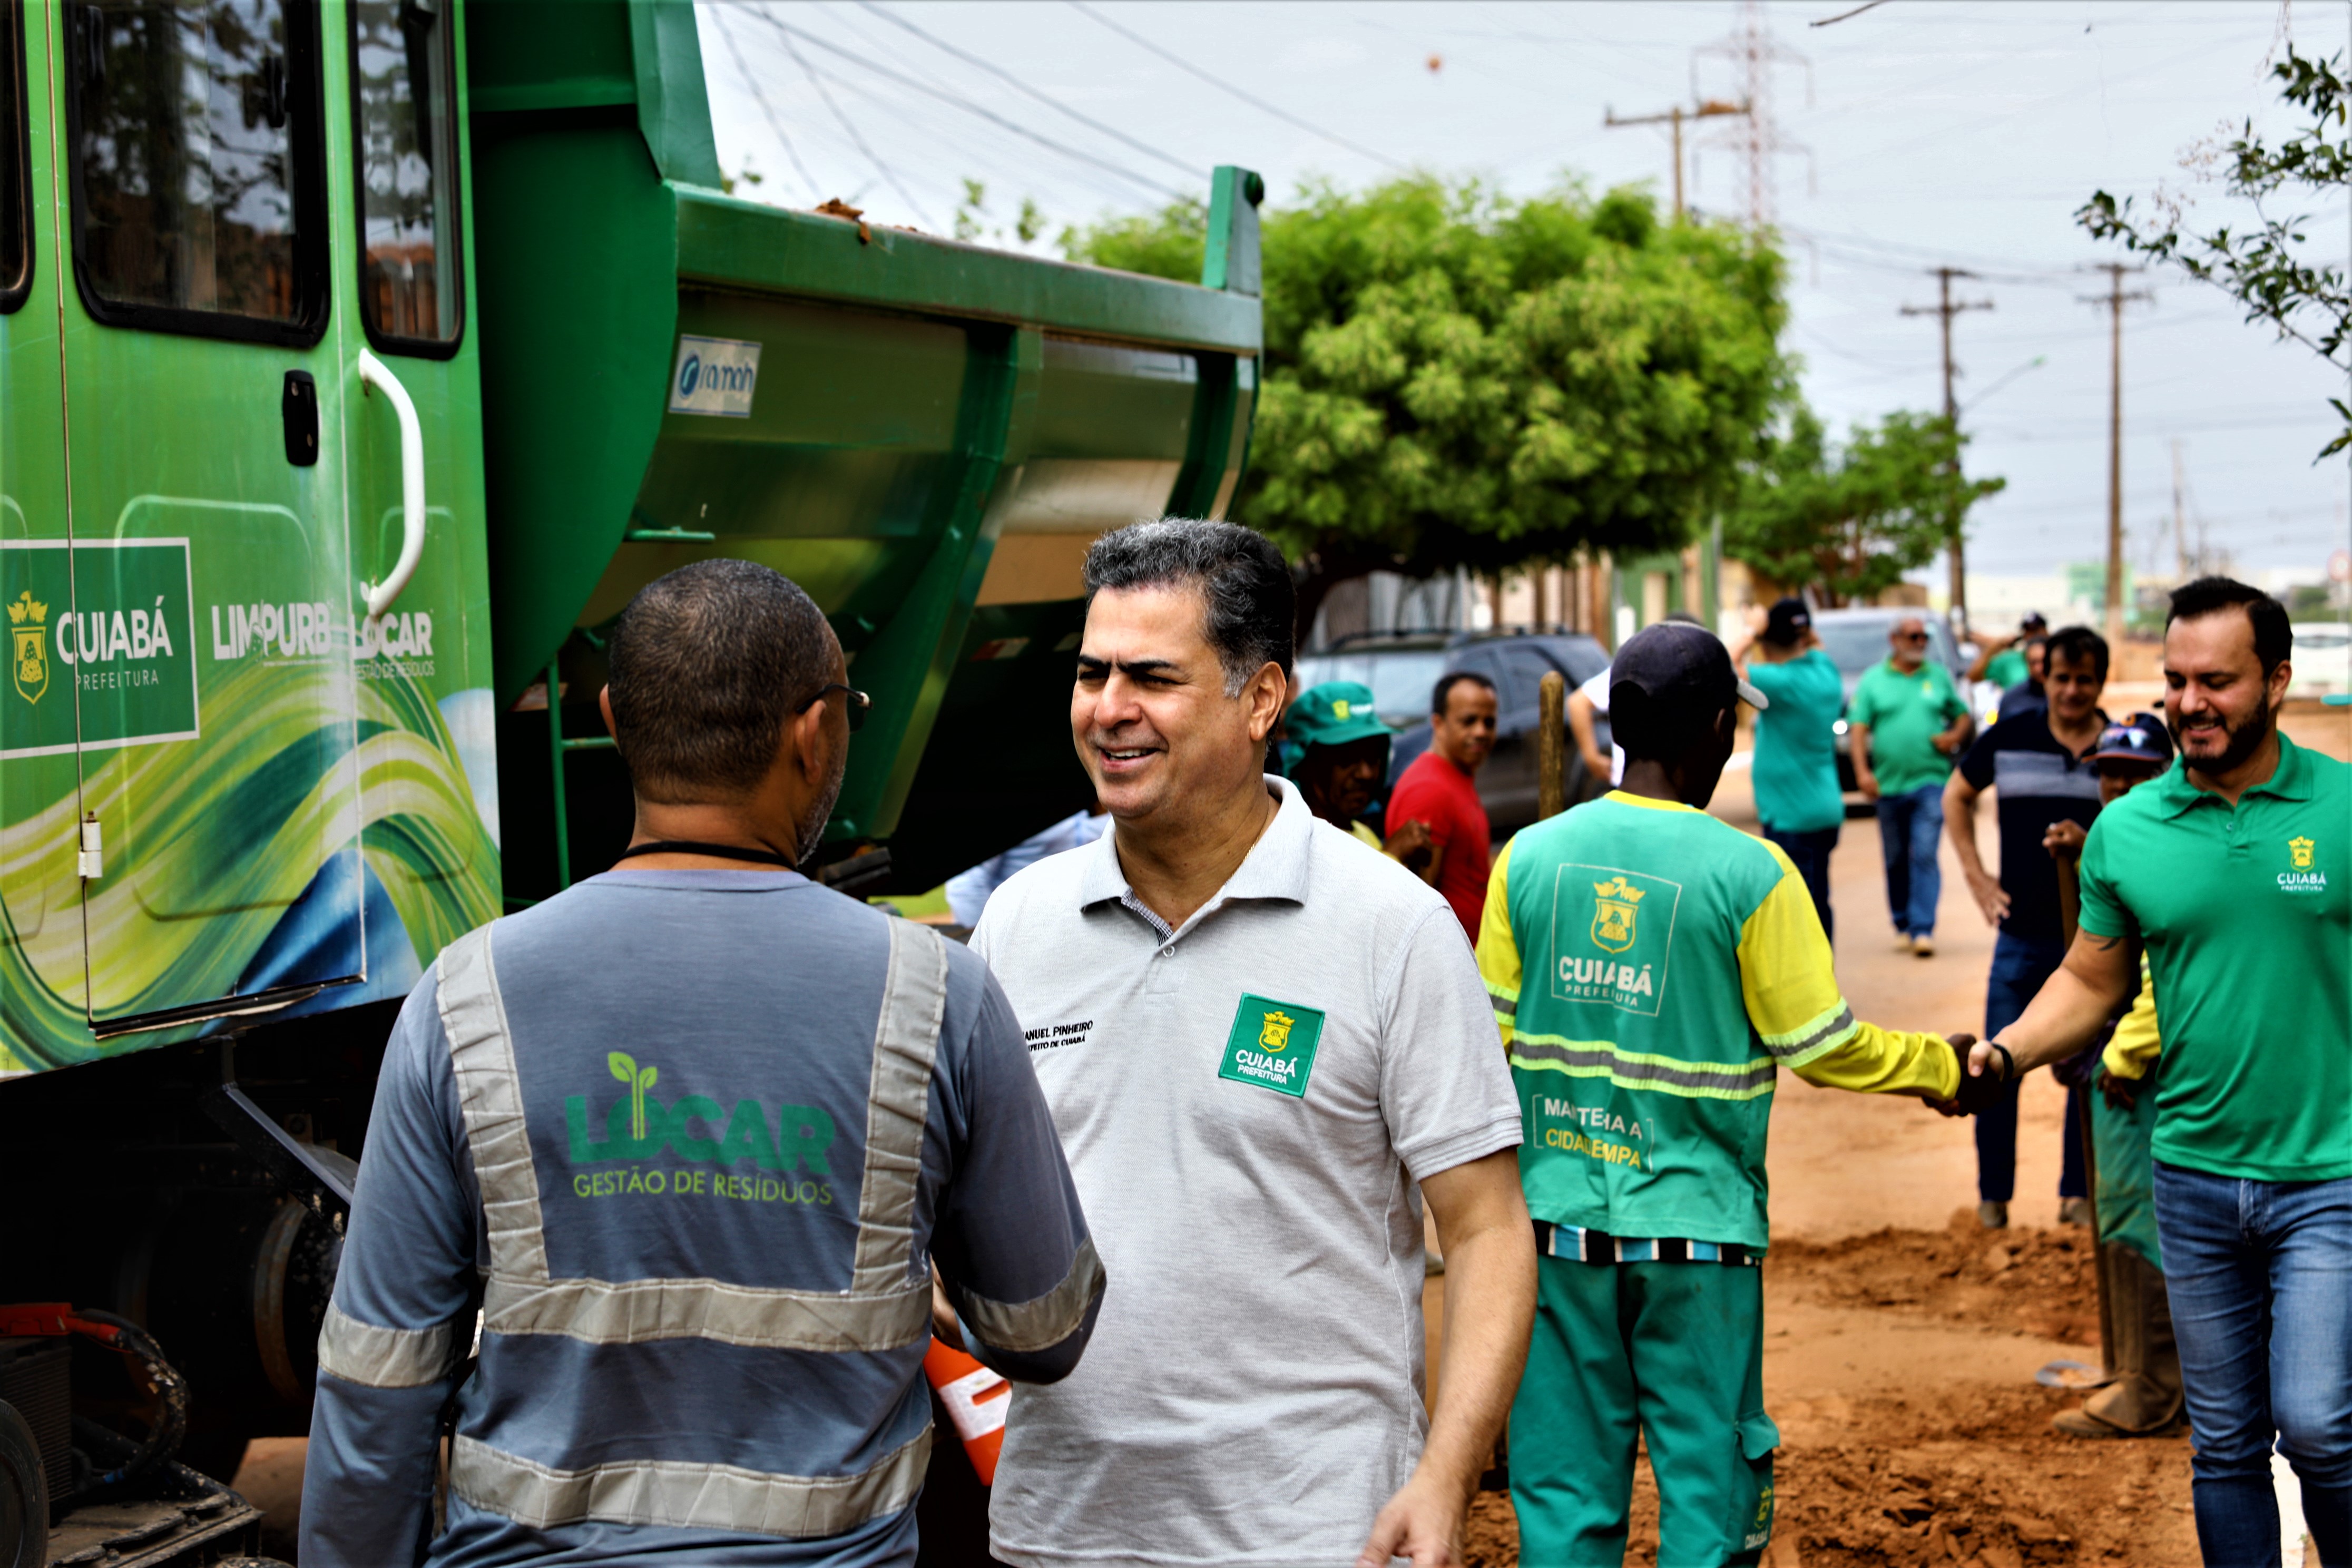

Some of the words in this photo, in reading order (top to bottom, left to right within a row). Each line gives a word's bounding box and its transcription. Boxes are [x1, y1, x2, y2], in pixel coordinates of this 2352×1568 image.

[56, 595, 173, 664] CUIABÁ
[211, 602, 332, 660] LIMPURB
[351, 612, 434, 660] LOCAR
[77, 669, 159, 691] PREFEITURA
[2277, 871, 2327, 885] CUIABÁ
[1559, 955, 1652, 997] CUIABÁ
[1023, 1027, 1051, 1041] ANUEL
[1053, 1020, 1093, 1037] PINHEIRO
[1028, 1042, 1049, 1052] FEITO
[1061, 1033, 1085, 1046] CUIABÁ
[1236, 1049, 1298, 1078] CUIABÁ
[1237, 1064, 1287, 1085] PREFEITURA
[565, 1094, 836, 1174] LOCAR
[1629, 1121, 1643, 1141] A
[573, 1165, 666, 1198] GESTÃO
[674, 1171, 705, 1194] DE
[713, 1173, 833, 1206] RESÍDUOS
